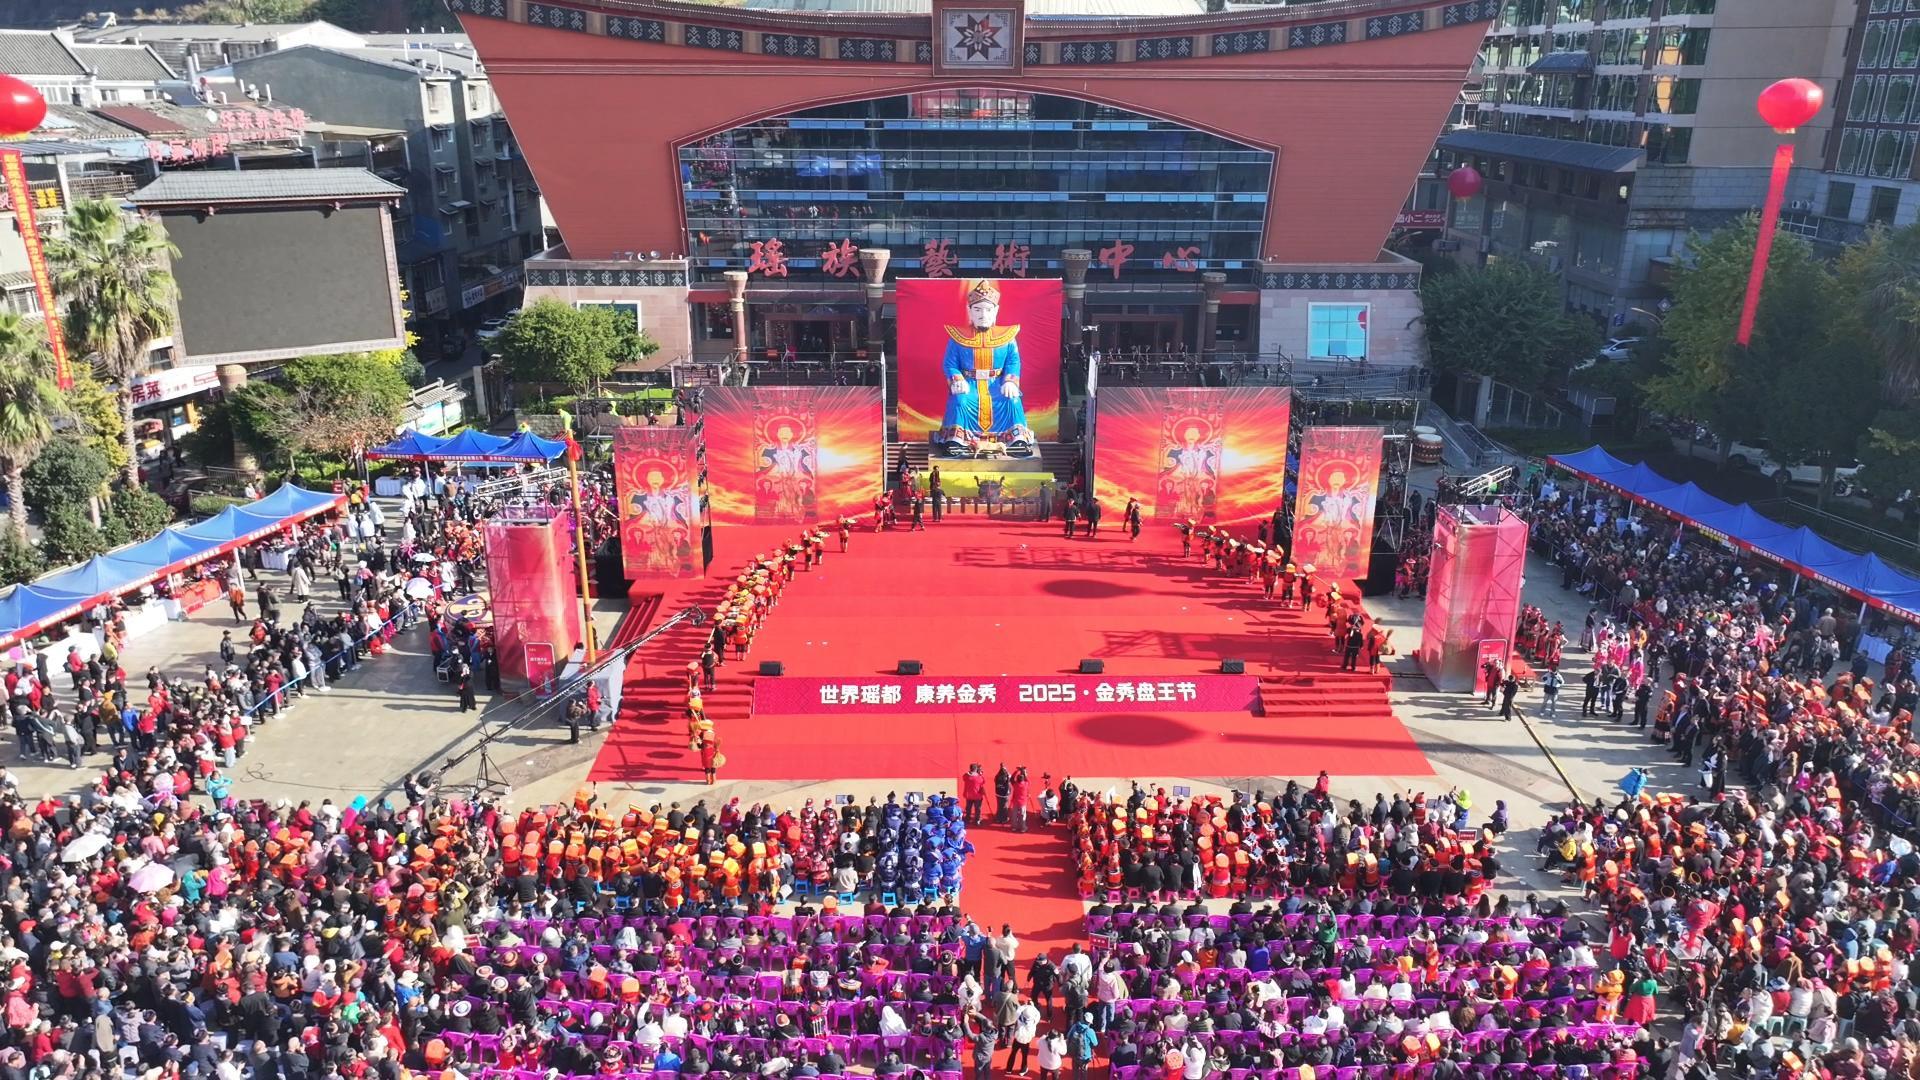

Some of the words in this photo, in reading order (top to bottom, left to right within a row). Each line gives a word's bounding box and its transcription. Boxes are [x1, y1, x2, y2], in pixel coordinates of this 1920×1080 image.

[819, 684, 902, 705] 世界瑶都
[915, 684, 997, 705] 康养金秀
[1019, 682, 1197, 703] 2025·金秀盘王节
